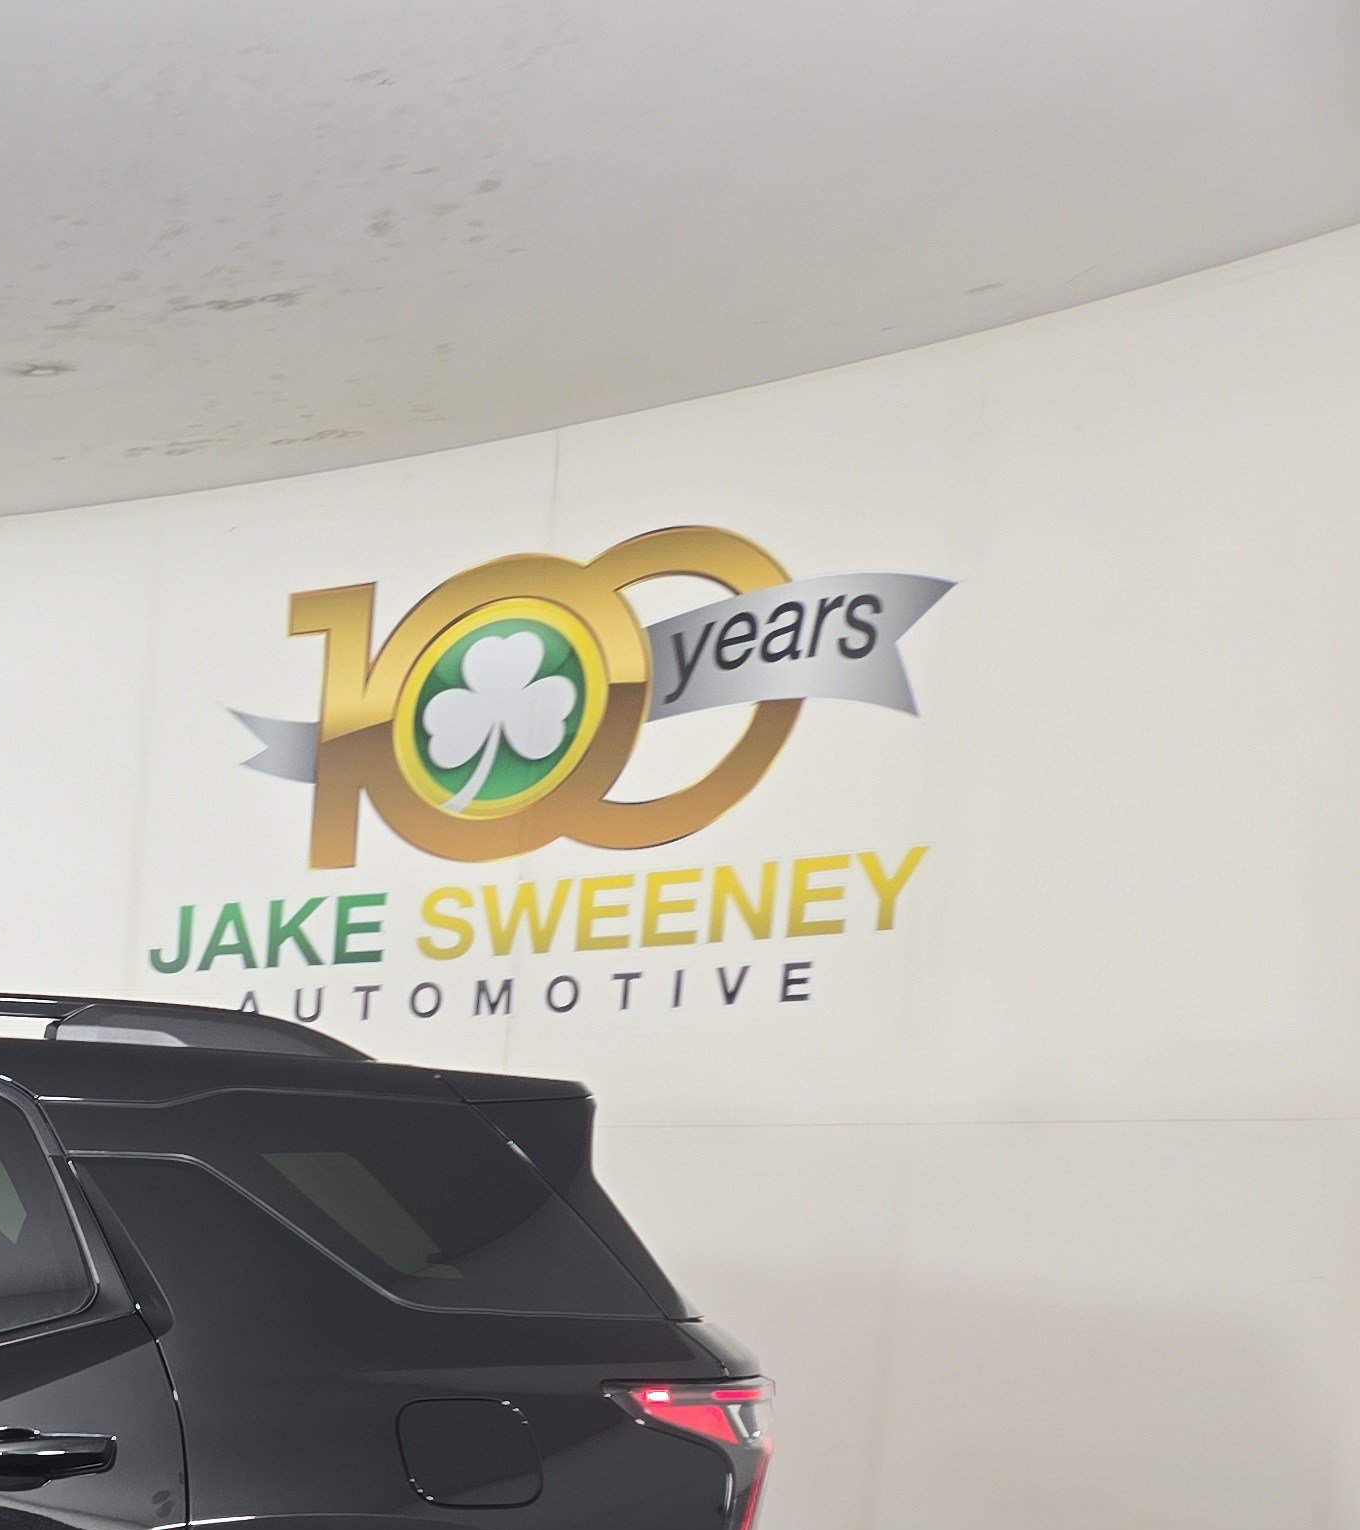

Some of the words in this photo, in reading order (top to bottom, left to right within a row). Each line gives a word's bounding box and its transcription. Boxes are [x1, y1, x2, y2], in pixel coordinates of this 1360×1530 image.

[663, 593, 881, 704] years
[148, 892, 388, 975] JAKE
[416, 844, 930, 960] SWEENEY
[240, 961, 816, 1025] AUTOMOTIVE
